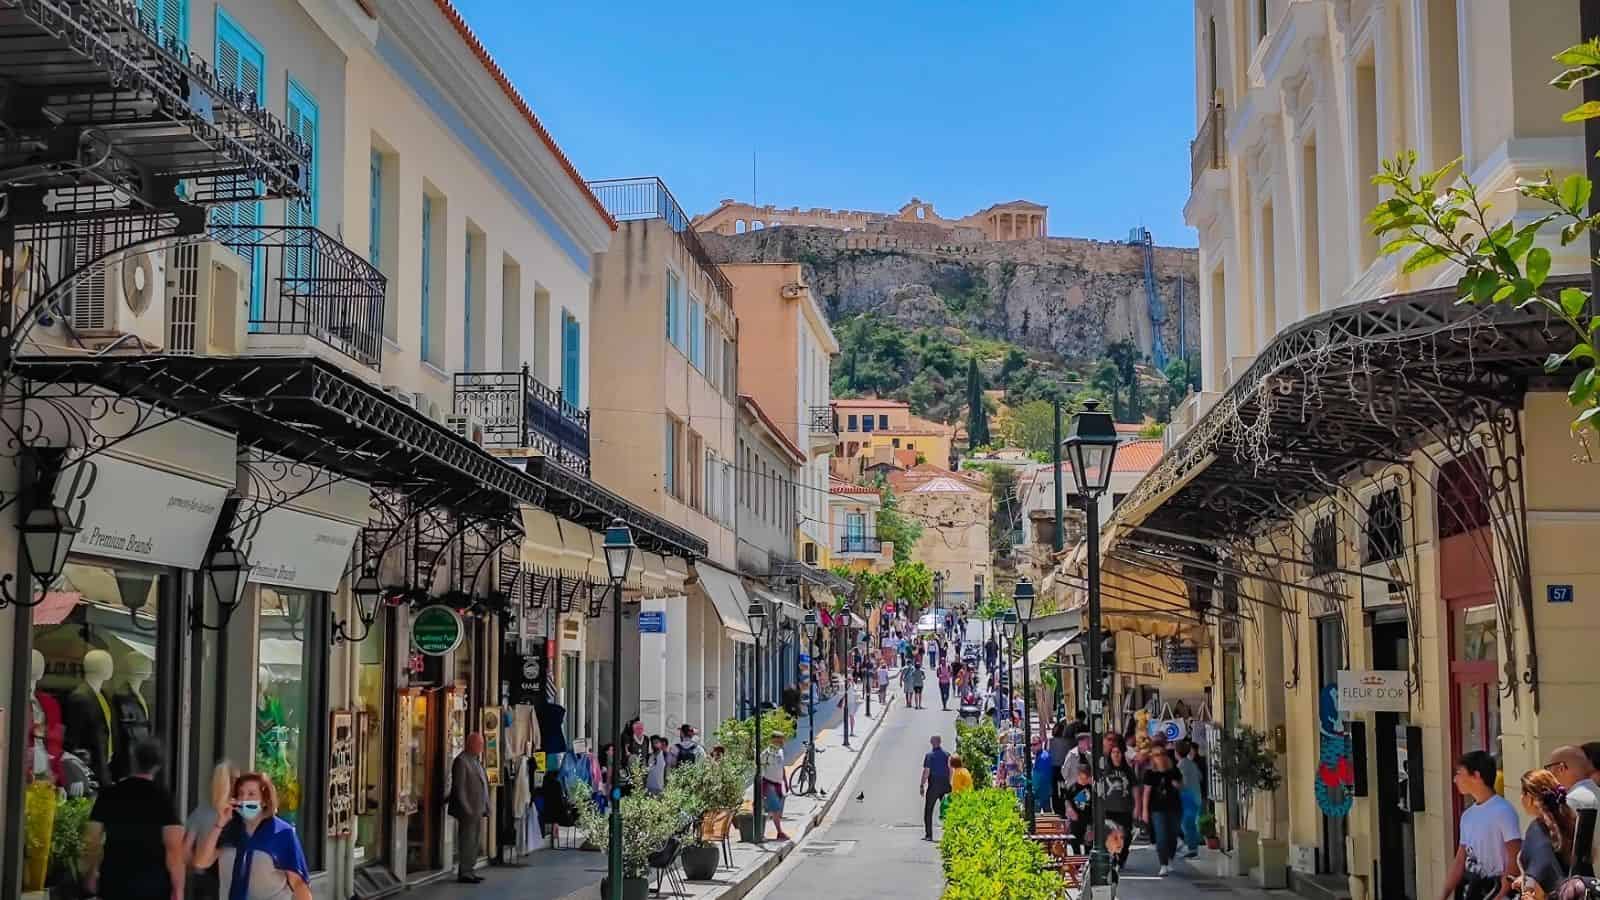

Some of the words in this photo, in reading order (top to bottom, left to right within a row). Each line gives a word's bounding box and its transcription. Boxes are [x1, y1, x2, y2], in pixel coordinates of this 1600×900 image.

[89, 527, 127, 550] Premium
[126, 534, 153, 554] Brands
[1553, 588, 1567, 600] 57
[1343, 687, 1373, 698] FLEUR
